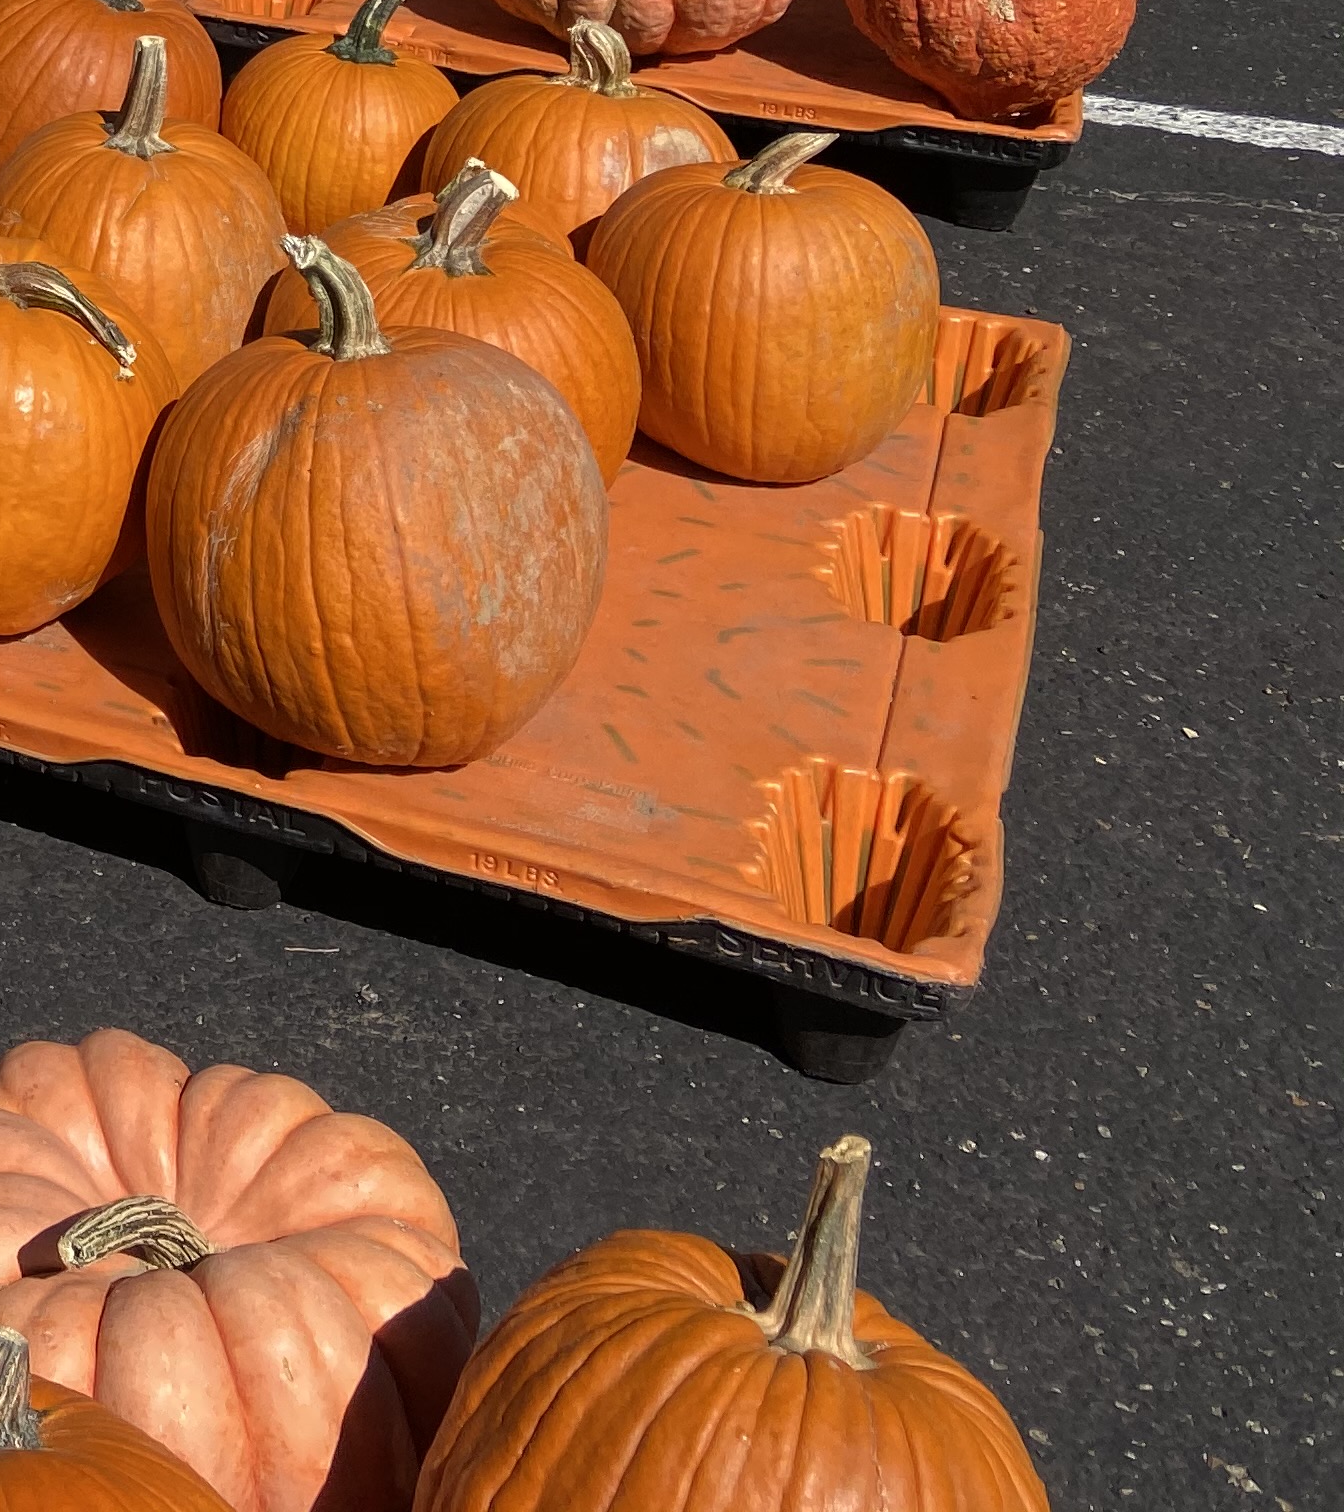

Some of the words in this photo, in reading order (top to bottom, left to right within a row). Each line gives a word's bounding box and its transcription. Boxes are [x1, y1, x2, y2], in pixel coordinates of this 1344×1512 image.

[138, 774, 307, 837] POSTAL
[469, 852, 499, 874] 19
[715, 928, 944, 1015] SERVICE
